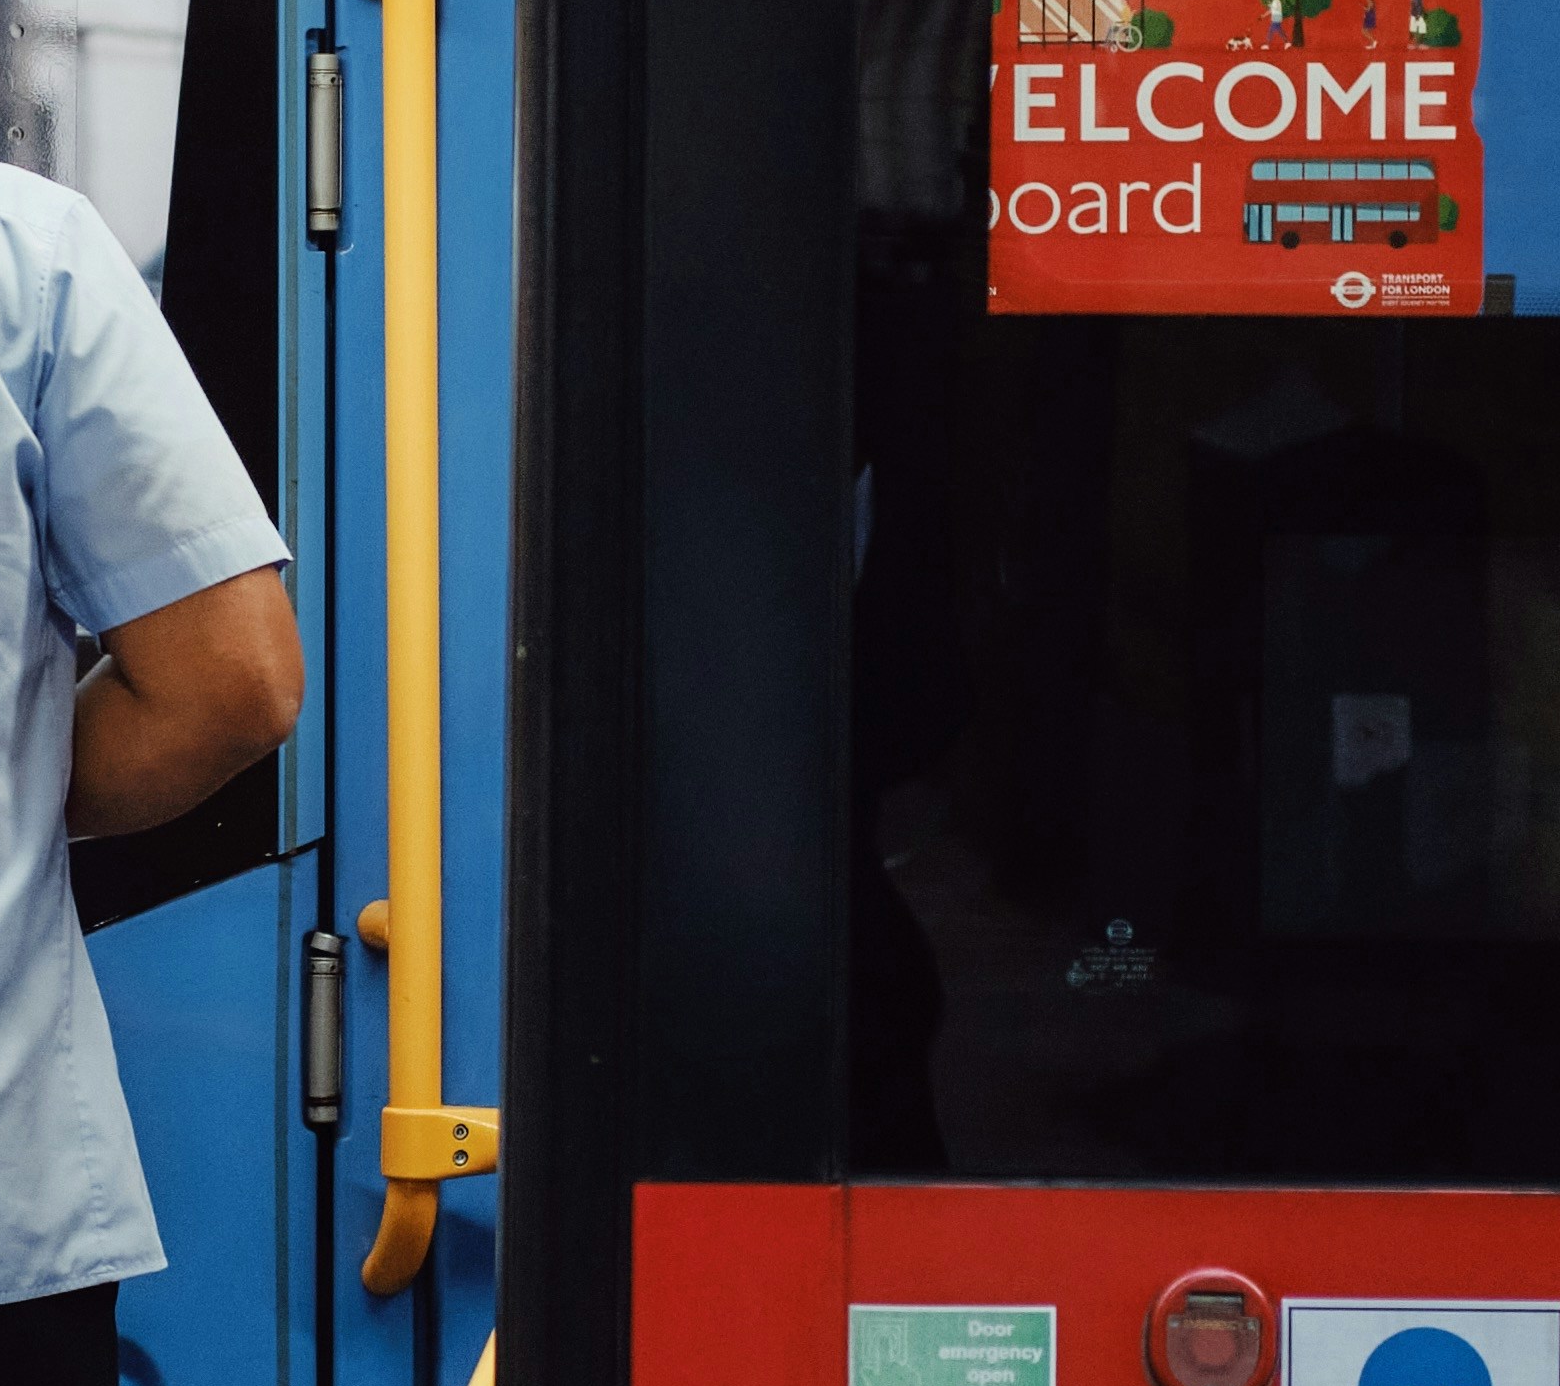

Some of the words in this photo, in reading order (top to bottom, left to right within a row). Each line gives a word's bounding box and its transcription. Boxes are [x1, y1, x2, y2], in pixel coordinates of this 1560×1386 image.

[990, 60, 1458, 142] ELCOME
[1381, 273, 1444, 284] TRANSPORT
[1381, 285, 1403, 295] FOR
[1405, 285, 1451, 295] LONDON
[967, 1319, 1017, 1338] Door
[937, 1344, 1044, 1365] emergency
[966, 1368, 1016, 1386] open
